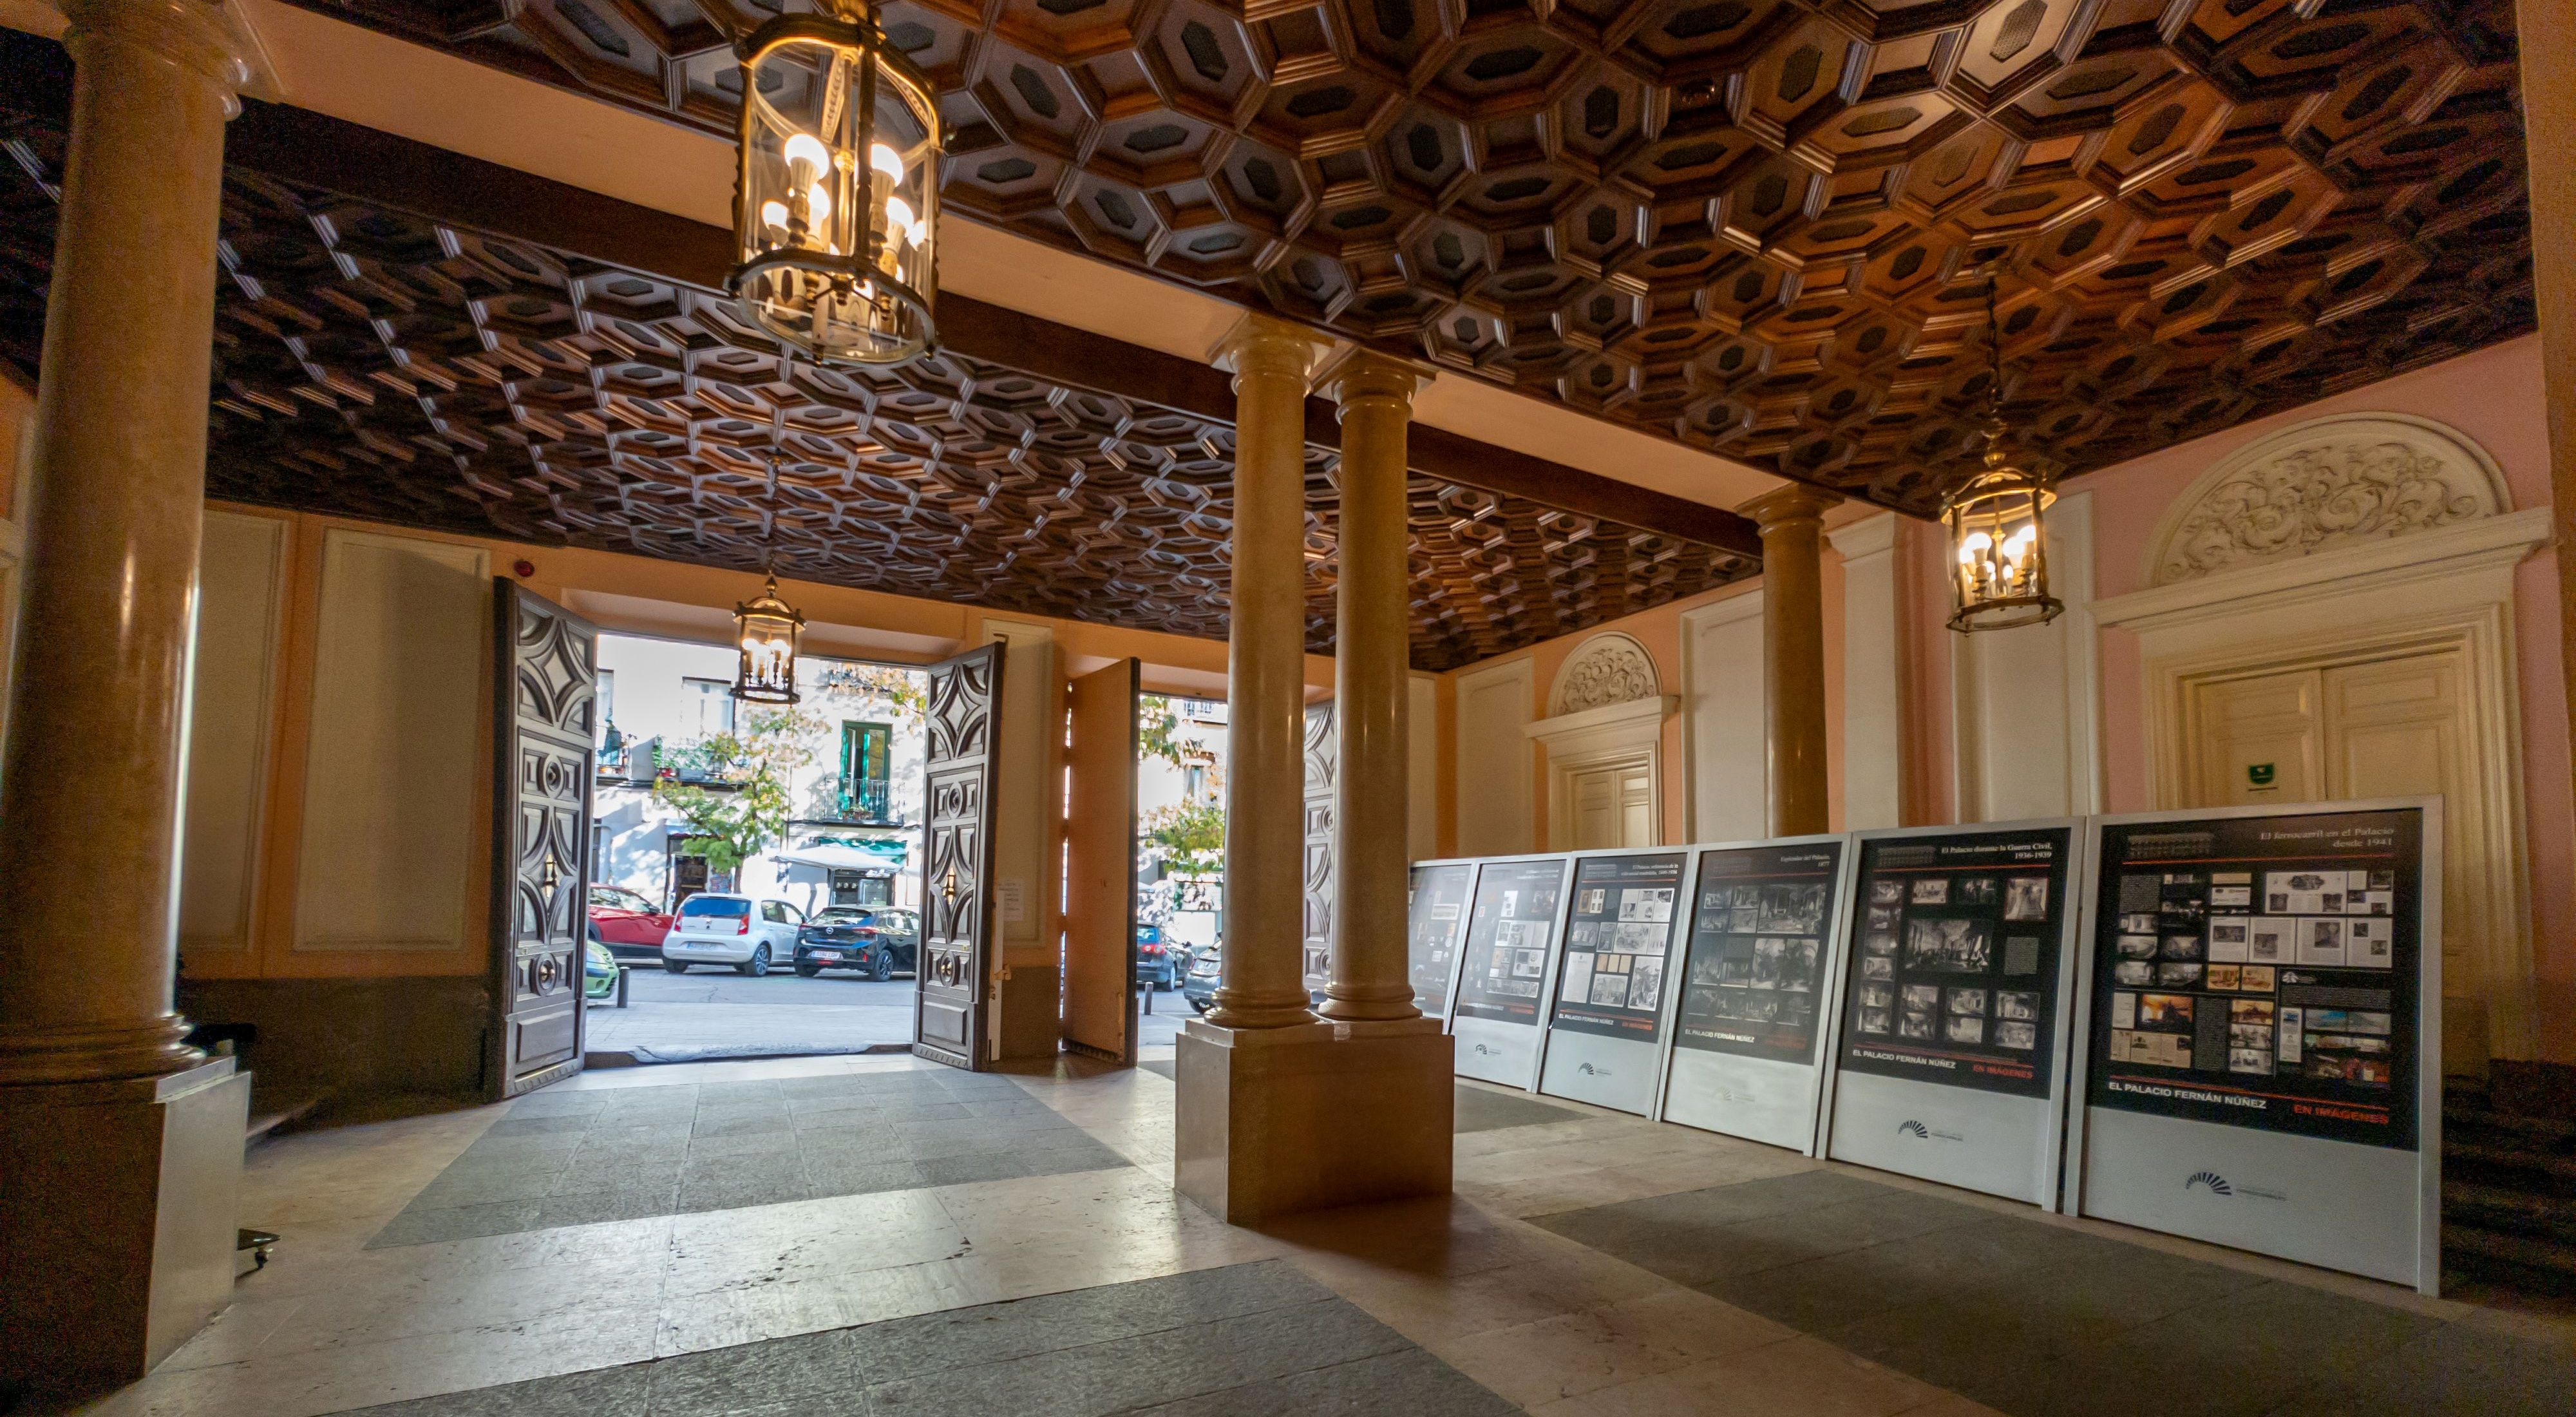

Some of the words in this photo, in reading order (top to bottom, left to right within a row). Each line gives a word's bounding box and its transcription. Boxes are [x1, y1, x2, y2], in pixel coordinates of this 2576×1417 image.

[1863, 1051, 1894, 1060] PALACIO
[1896, 1054, 1927, 1064] FERNÁN
[1929, 1058, 1956, 1069] NÚÑEZ
[2109, 1081, 2122, 1091] EL
[2125, 1083, 2172, 1097] PALACIO
[2174, 1089, 2221, 1103] FERNÁN
[2224, 1095, 2267, 1109] NÚÑEZ
[2293, 1104, 2311, 1115] EN
